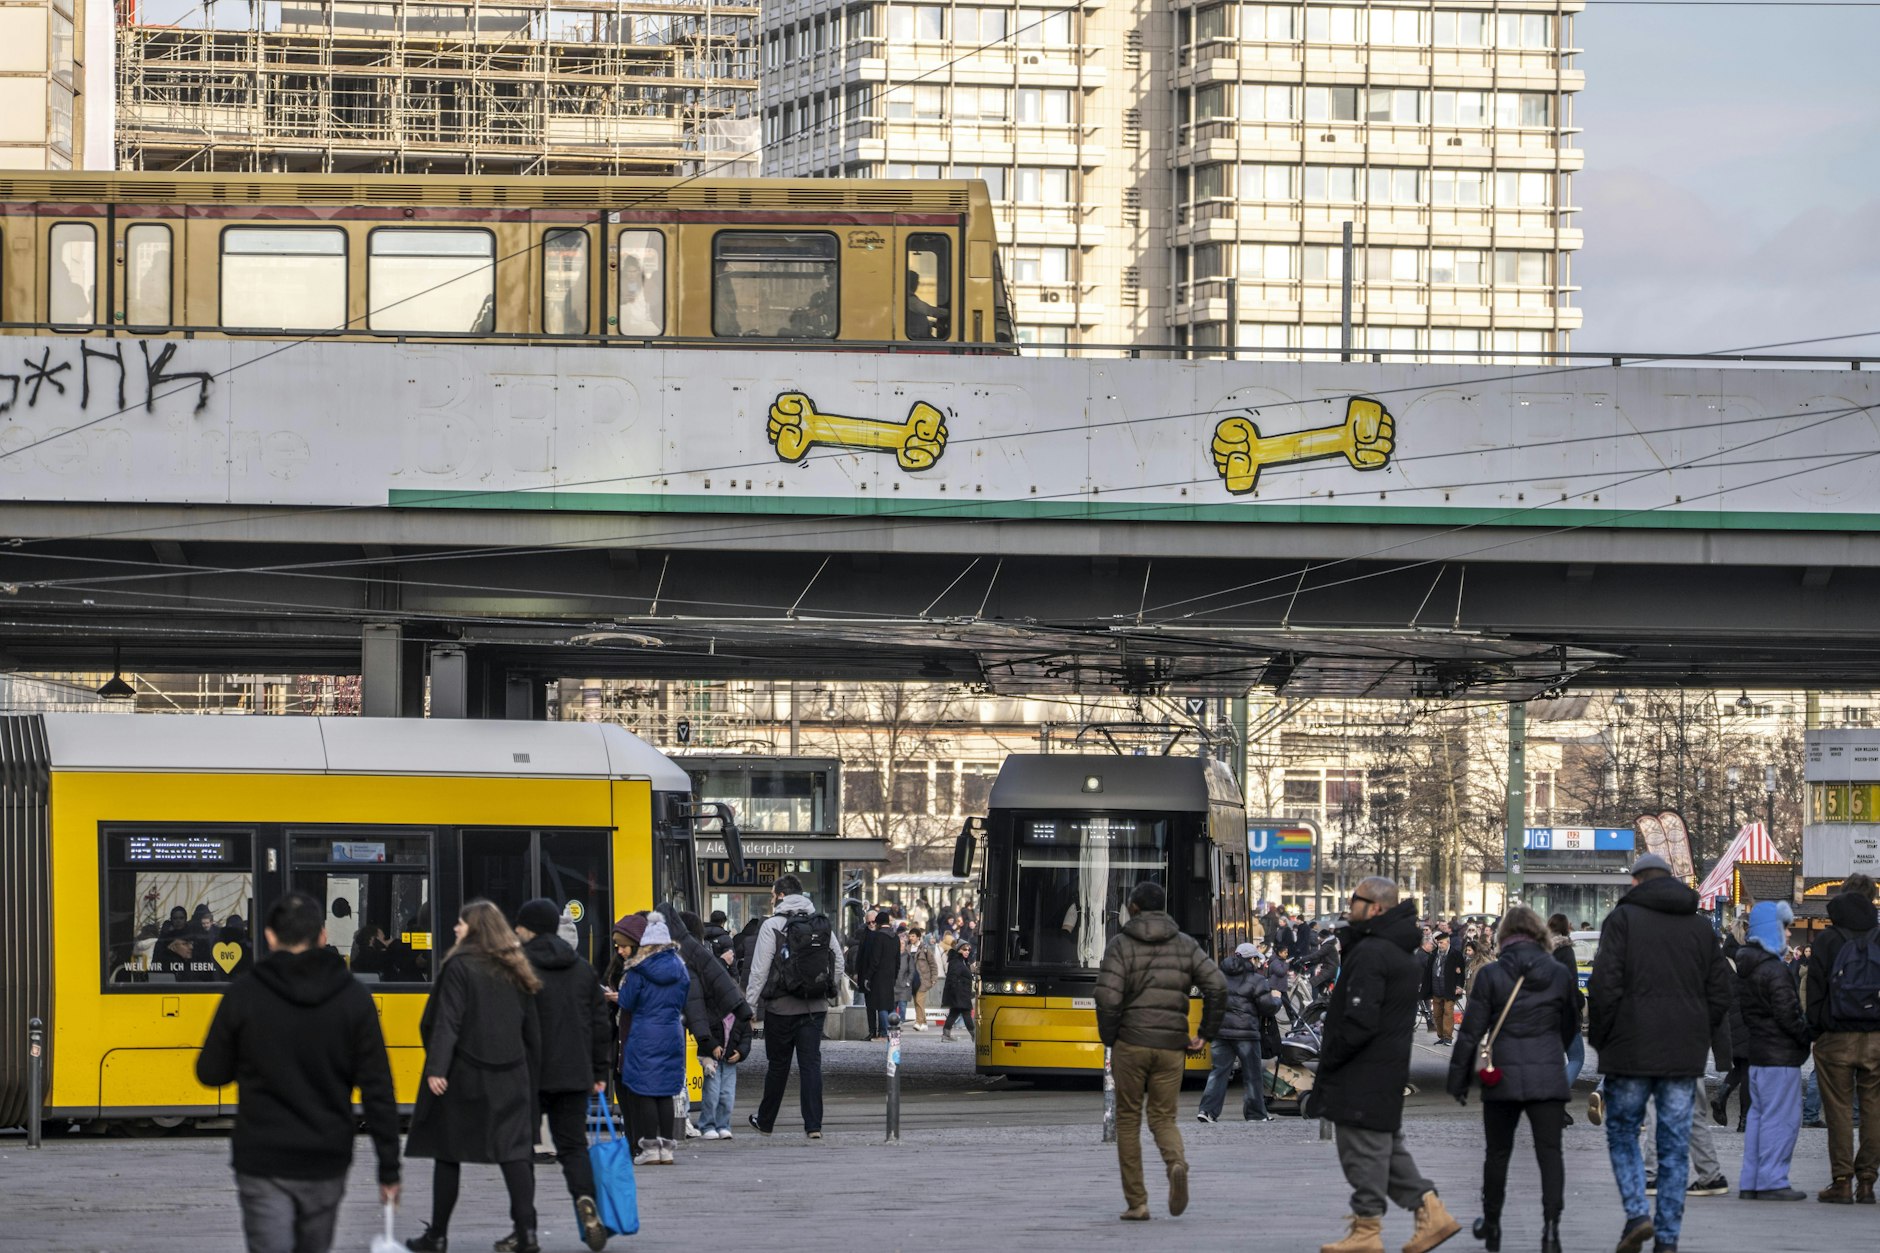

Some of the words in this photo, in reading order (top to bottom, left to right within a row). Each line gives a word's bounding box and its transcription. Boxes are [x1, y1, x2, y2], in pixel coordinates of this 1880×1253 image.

[1828, 790, 1837, 814] 5
[1851, 790, 1863, 814] 6
[1248, 831, 1268, 853] U
[760, 863, 775, 872] U5
[712, 862, 730, 884] U
[760, 875, 775, 883] U8
[220, 951, 234, 960] BVG
[124, 962, 144, 971] WEIL
[147, 962, 162, 971] WIR
